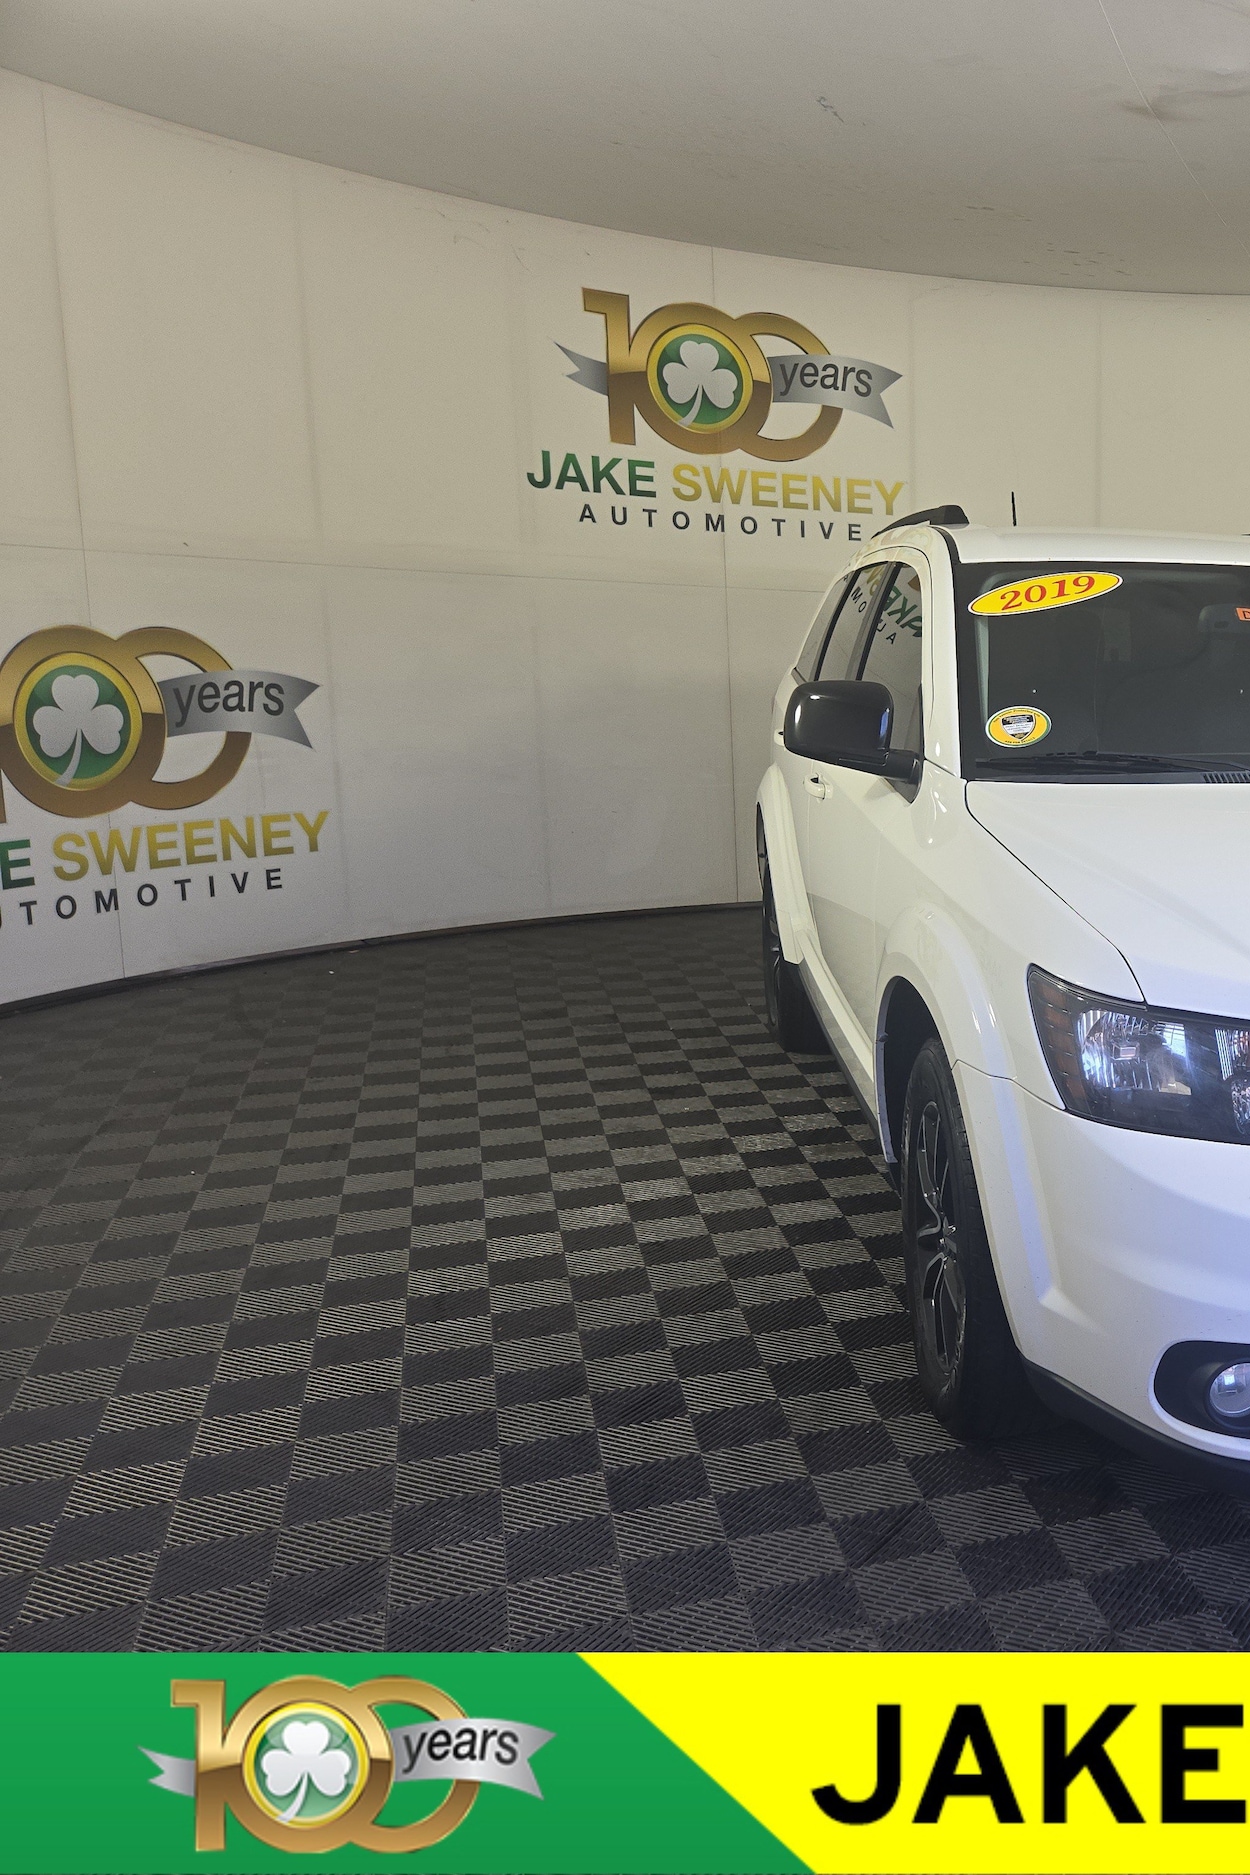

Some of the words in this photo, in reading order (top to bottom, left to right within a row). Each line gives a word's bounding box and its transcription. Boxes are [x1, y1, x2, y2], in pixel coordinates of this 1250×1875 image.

[582, 287, 843, 463] 100
[780, 361, 874, 398] years
[527, 450, 657, 498] JAKE
[672, 463, 904, 516] SWEENEY
[579, 503, 862, 541] AUTOMOTIVE
[1000, 575, 1095, 611] 2019
[0, 624, 252, 823] 00
[173, 679, 285, 728] years
[52, 811, 330, 882] SWEENEY
[0, 868, 283, 930] TOMOTIVE
